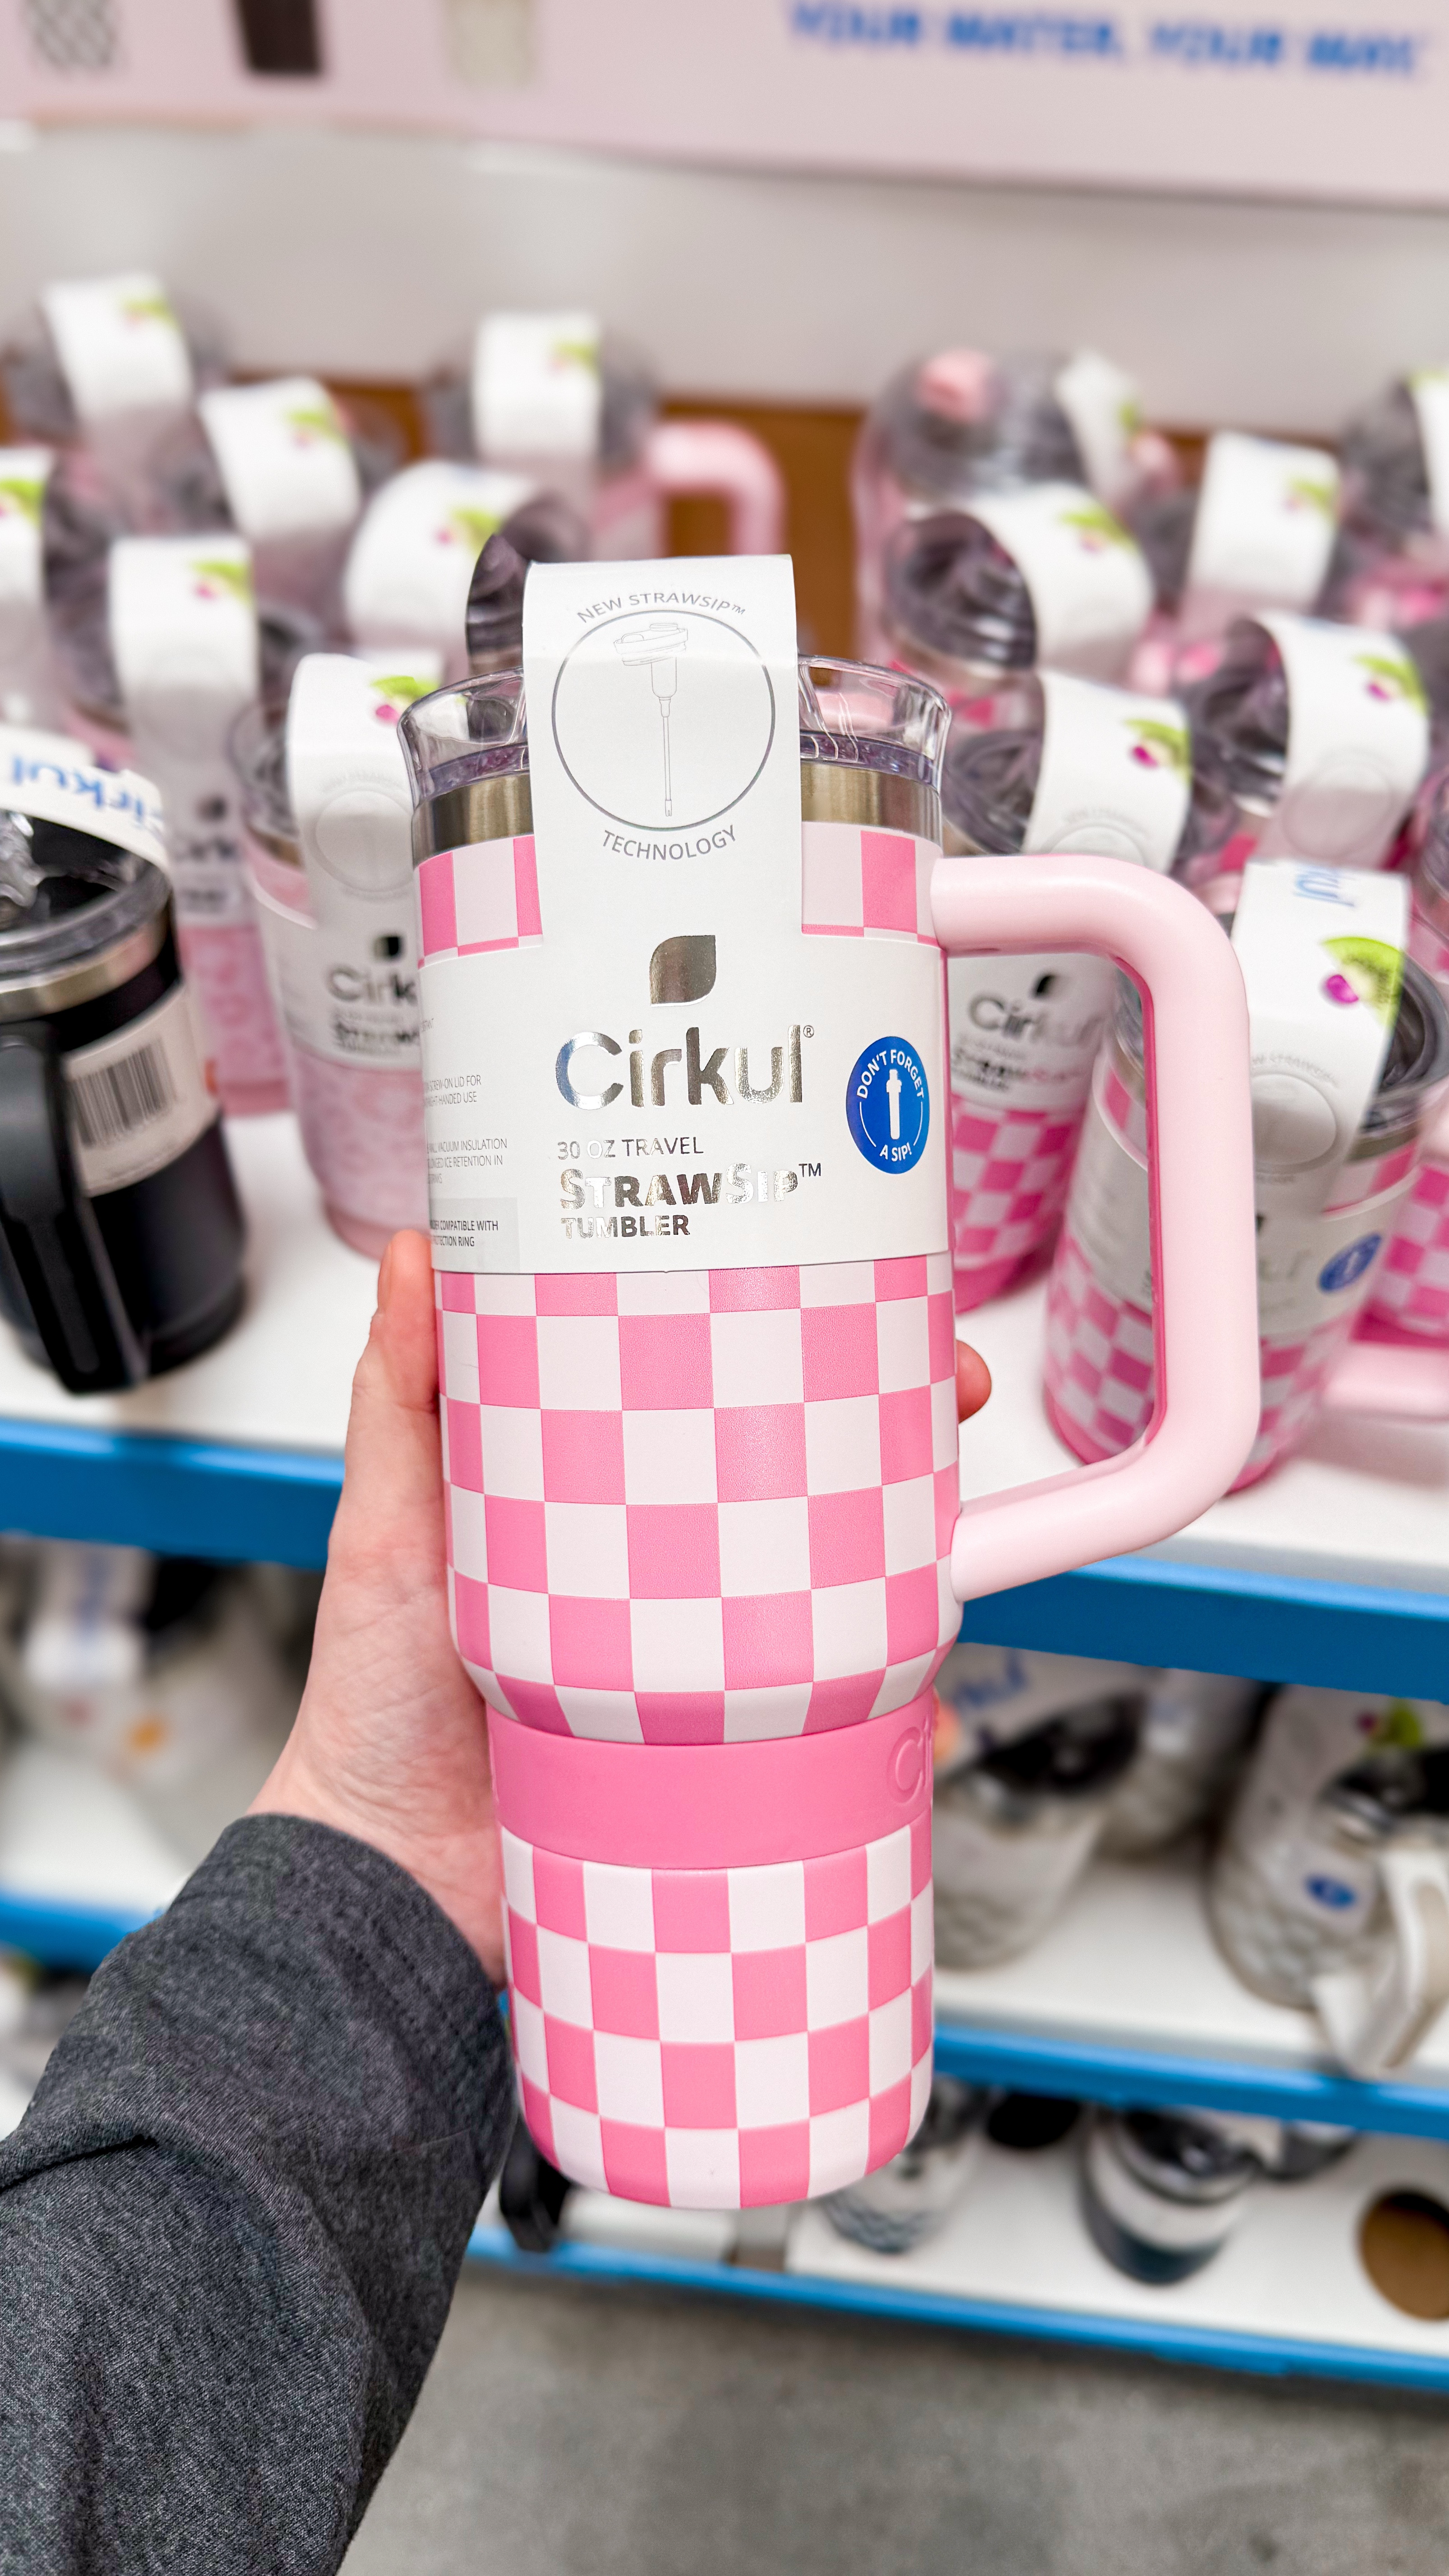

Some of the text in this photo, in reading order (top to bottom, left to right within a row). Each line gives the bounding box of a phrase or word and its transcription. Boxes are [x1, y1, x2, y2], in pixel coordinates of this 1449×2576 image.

[577, 597, 623, 624] NEW
[602, 824, 737, 860] TECHNOLOGY
[454, 1076, 465, 1088] LID
[467, 1074, 481, 1086] FOR
[857, 1050, 887, 1099] DON'T
[890, 1049, 924, 1099] FORGET
[463, 1091, 477, 1103] USE
[438, 1141, 459, 1152] VACUUM
[461, 1138, 507, 1151] INSULATION
[557, 1136, 704, 1160] 30 OZ TRAVEL
[879, 1142, 912, 1162] A SIP!
[444, 1157, 453, 1168] ICE
[453, 1155, 492, 1167] RETENTION
[494, 1155, 503, 1166] IN
[440, 1220, 475, 1231] COMPATIBLE
[477, 1220, 499, 1231] WITH
[560, 1214, 691, 1239] TUMBLER
[458, 1236, 475, 1247] RING
